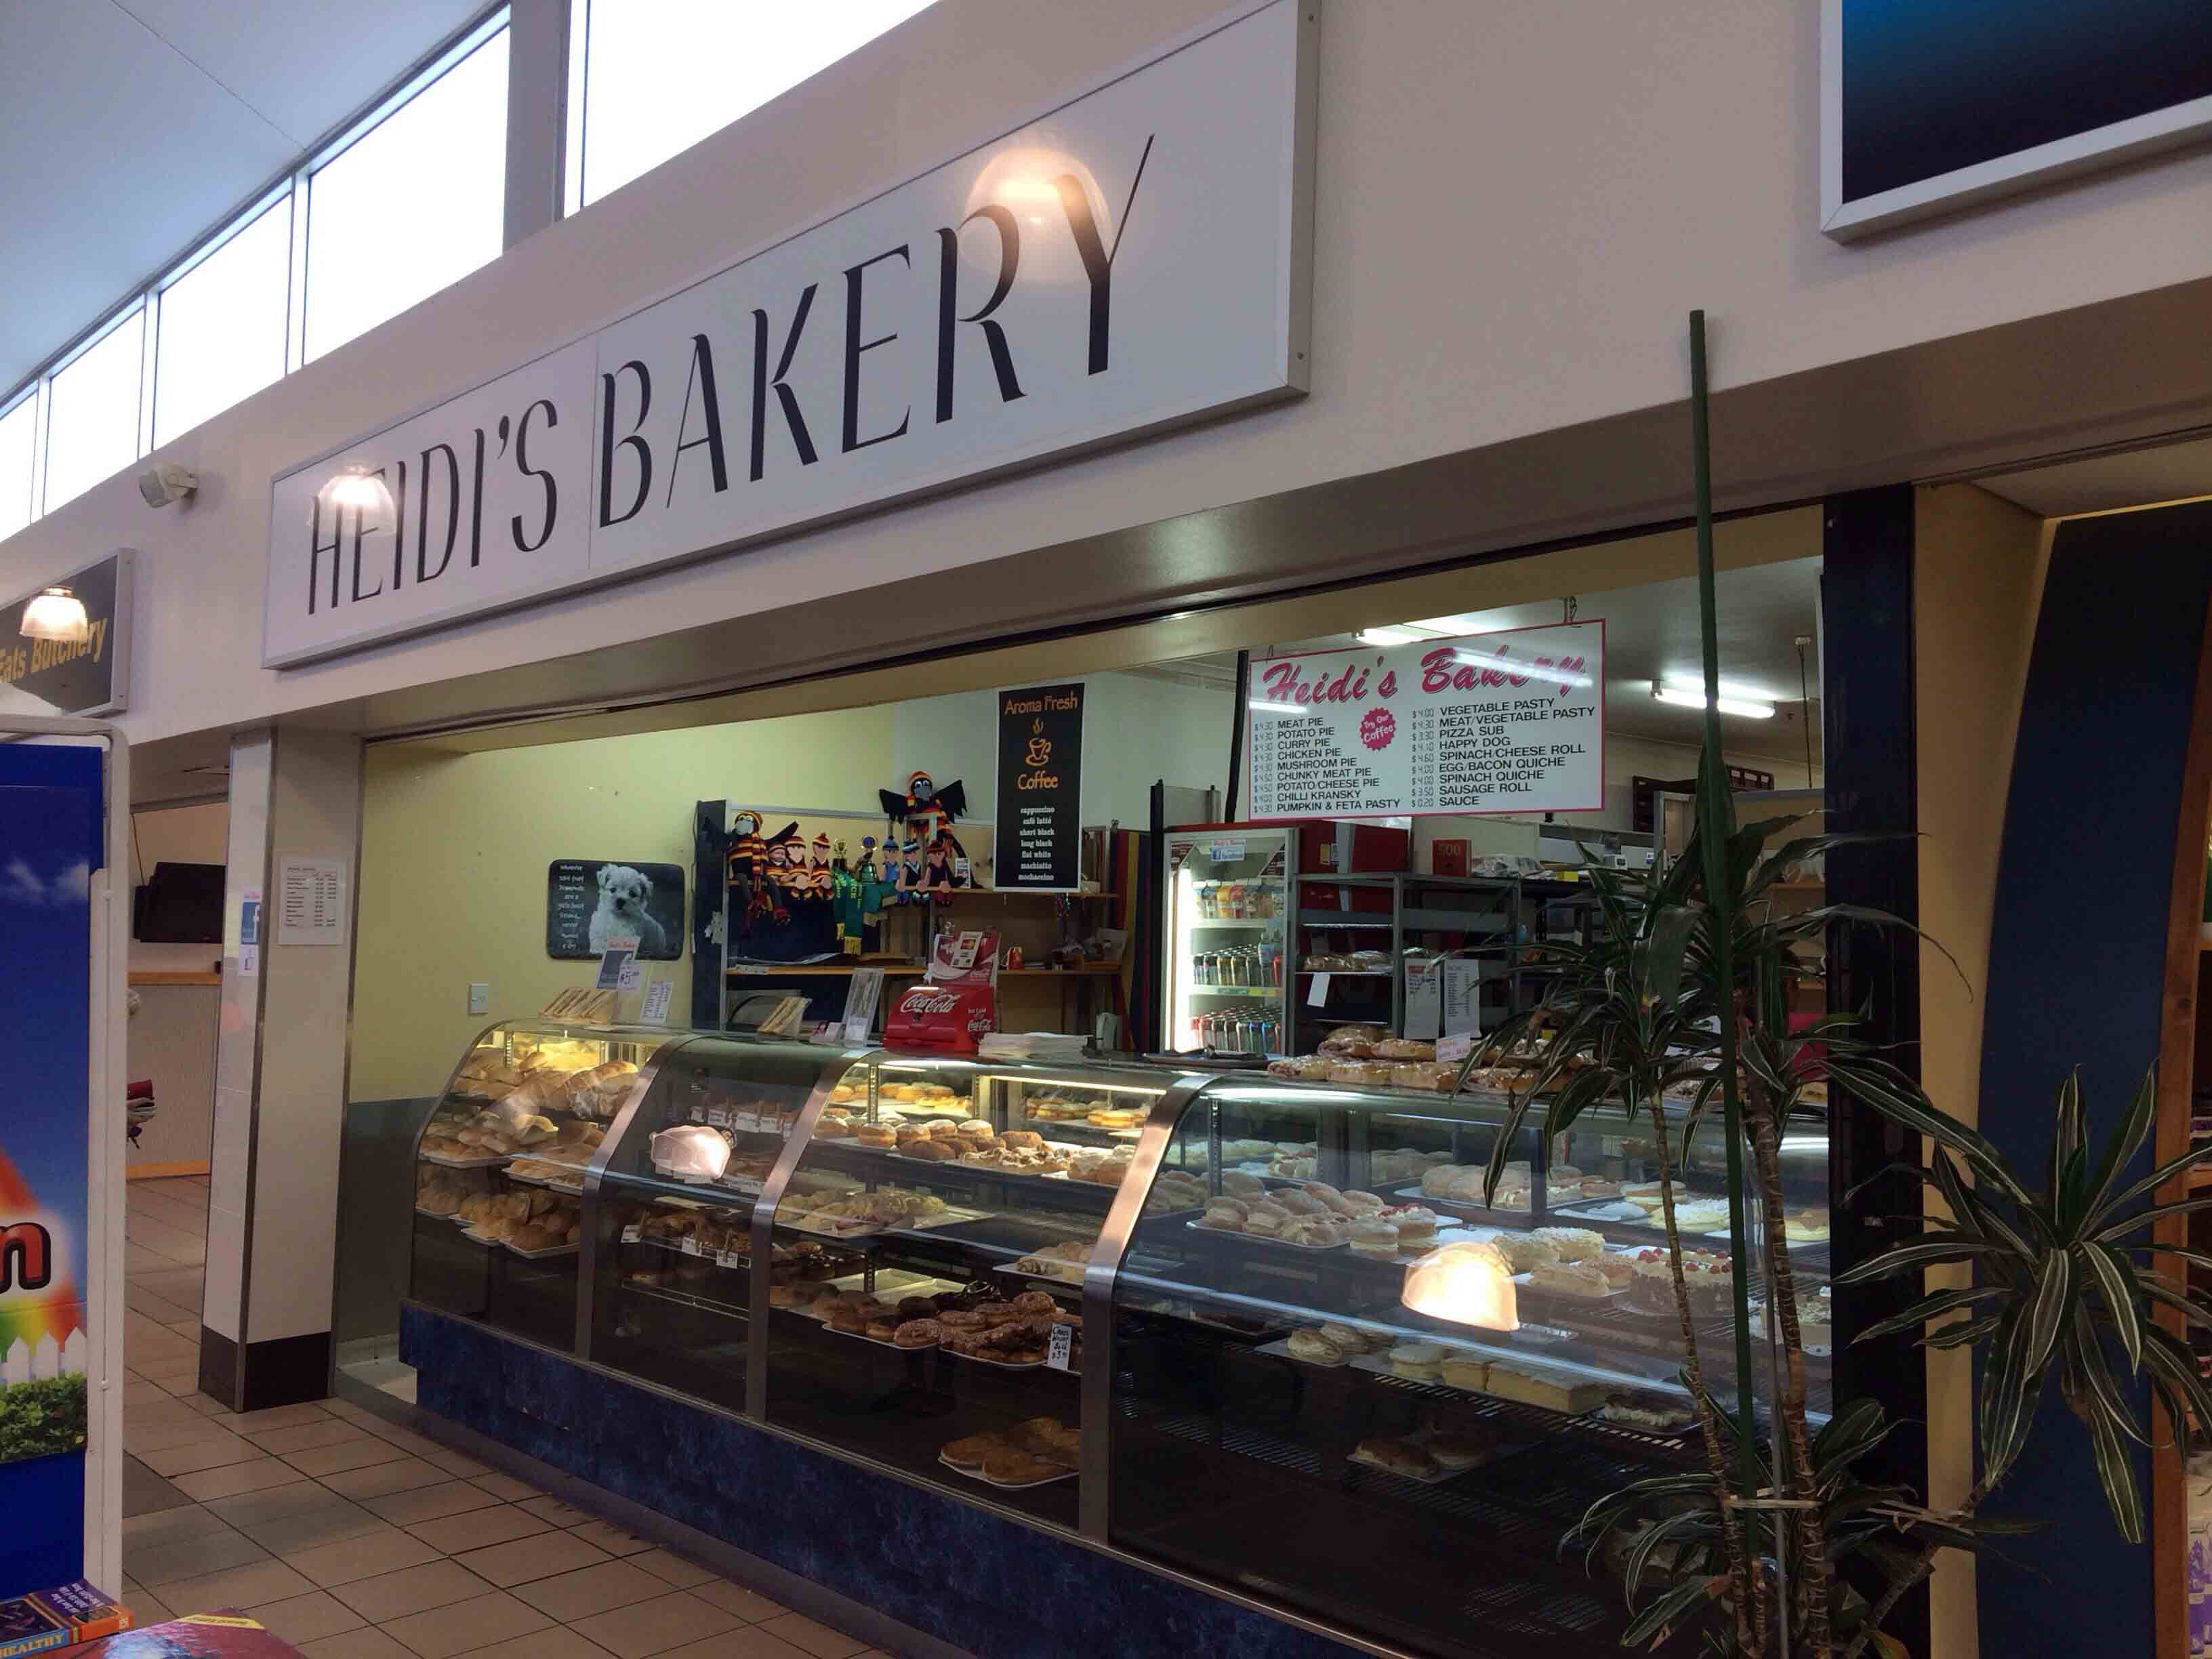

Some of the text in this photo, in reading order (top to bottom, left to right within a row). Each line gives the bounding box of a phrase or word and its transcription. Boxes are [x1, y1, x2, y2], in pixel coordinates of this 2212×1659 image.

[309, 134, 1155, 615] HEIDI'S BAKERY
[1263, 655, 1398, 705] Heidi's
[1004, 691, 1078, 716] Aroma Fresh
[1439, 701, 1509, 716] VEGETABLE
[1514, 698, 1555, 710] PASTY
[1553, 707, 1595, 720] PASTY
[1277, 718, 1303, 729] MEAT
[1308, 717, 1324, 726] PIE
[1277, 729, 1315, 739] POTATO
[1319, 727, 1334, 736] PIE
[1364, 725, 1394, 742] Coffee
[1439, 728, 1474, 739] PIZZA
[1479, 725, 1504, 737] SUB
[1277, 739, 1311, 750] CURRY
[1315, 738, 1330, 747] PIE
[1439, 739, 1478, 750] HAPPY
[1482, 737, 1511, 747] DOG
[1551, 744, 1586, 754] ROLL
[1277, 749, 1322, 760] CHICKEN
[1325, 748, 1341, 757] PIE
[1277, 759, 1337, 771] MUSHROOM
[1340, 758, 1357, 766] PIE
[1516, 757, 1566, 768] QUICHE
[1018, 770, 1059, 790] Coffee
[1277, 771, 1319, 781] CHUNKY
[1323, 769, 1351, 778] MEAT
[1355, 768, 1372, 777] PIE
[1439, 773, 1492, 784] SPINACH
[1496, 770, 1545, 781] QUICHE
[1363, 778, 1380, 787] PIE
[1439, 783, 1496, 796] SAUSAGE
[1499, 782, 1532, 792] ROLL
[1277, 792, 1308, 802] CHILLI
[1311, 790, 1361, 801] KRANSKY
[1439, 796, 1480, 806] SAUCE
[1277, 802, 1322, 813] PUMPKIN
[1325, 801, 1332, 811] &
[1336, 800, 1362, 811] FETA
[1366, 799, 1401, 808] PASTY
[1021, 840, 1035, 848] long
